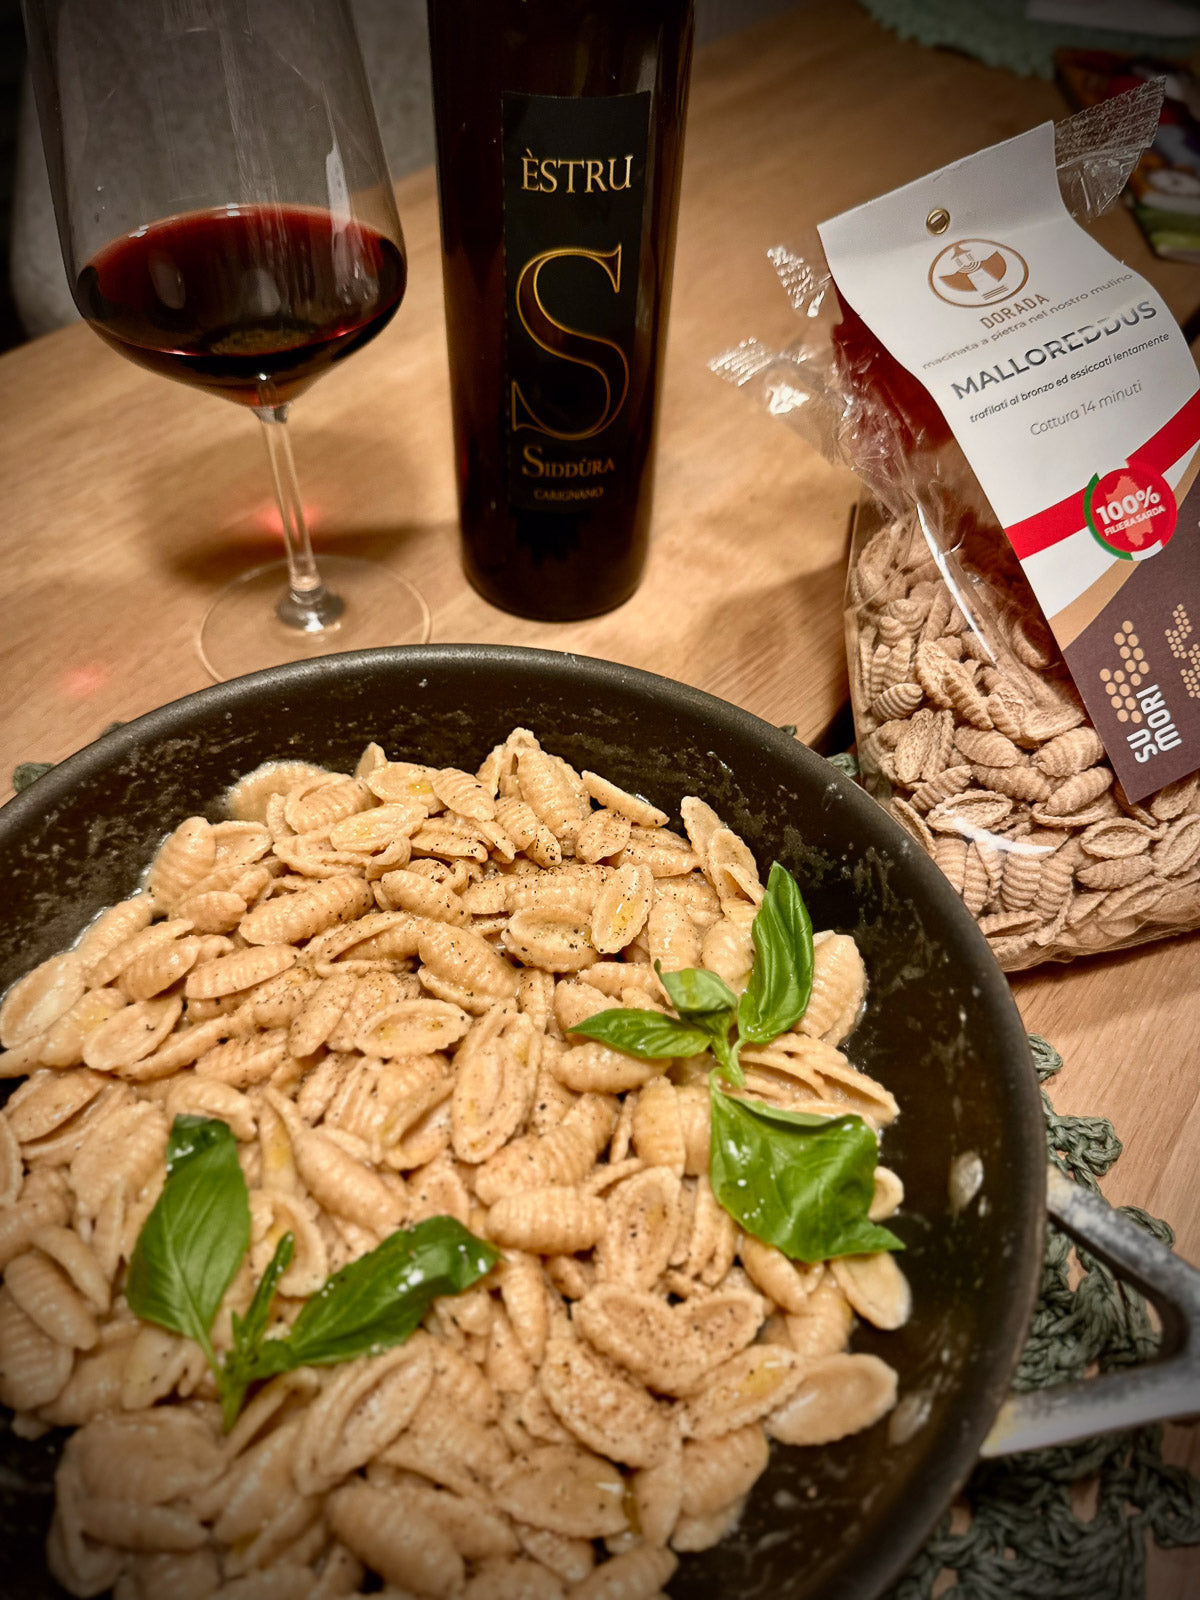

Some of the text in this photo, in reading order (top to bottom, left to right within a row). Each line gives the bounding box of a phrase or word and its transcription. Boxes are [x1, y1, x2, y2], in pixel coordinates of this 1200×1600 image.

[521, 148, 634, 194] ÈSTRU
[511, 242, 629, 441] S
[922, 343, 979, 370] macinata
[991, 321, 1027, 342] pietra
[1029, 311, 1048, 324] nel
[1049, 293, 1089, 314] nostro
[1090, 274, 1133, 295] mulino
[979, 293, 1050, 329] DORADA
[950, 301, 1158, 401] MALLOREDDUS
[969, 333, 1170, 424] trafilati al bronzo ed essiccati lentamente
[1030, 379, 1143, 437] Cottura 14 minuti
[1095, 485, 1161, 525] 100%
[1126, 727, 1158, 764] SU
[1136, 684, 1182, 752] MORI
